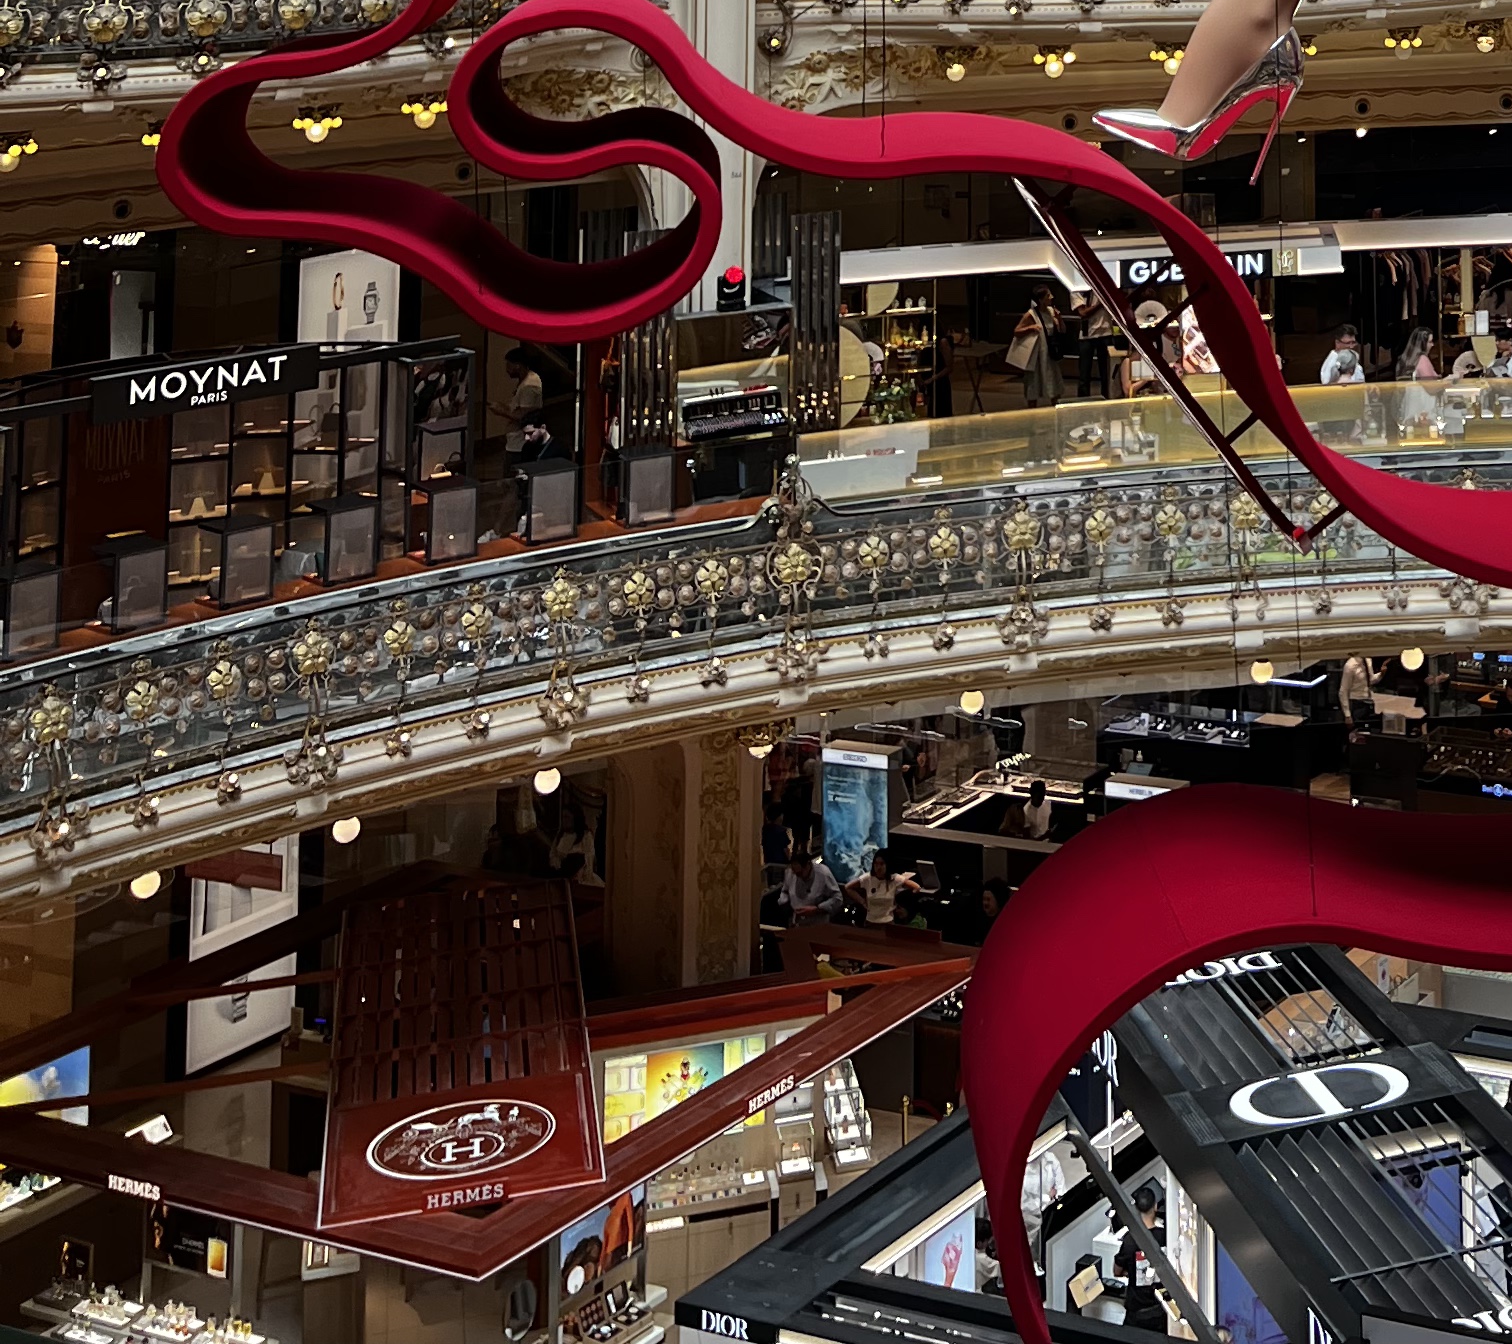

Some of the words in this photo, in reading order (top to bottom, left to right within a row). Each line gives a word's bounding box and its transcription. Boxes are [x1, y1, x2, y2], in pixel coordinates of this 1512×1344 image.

[129, 354, 288, 406] MOYNAT
[190, 390, 228, 406] PARIS
[440, 1136, 485, 1163] H
[701, 1309, 749, 1340] DIOR
